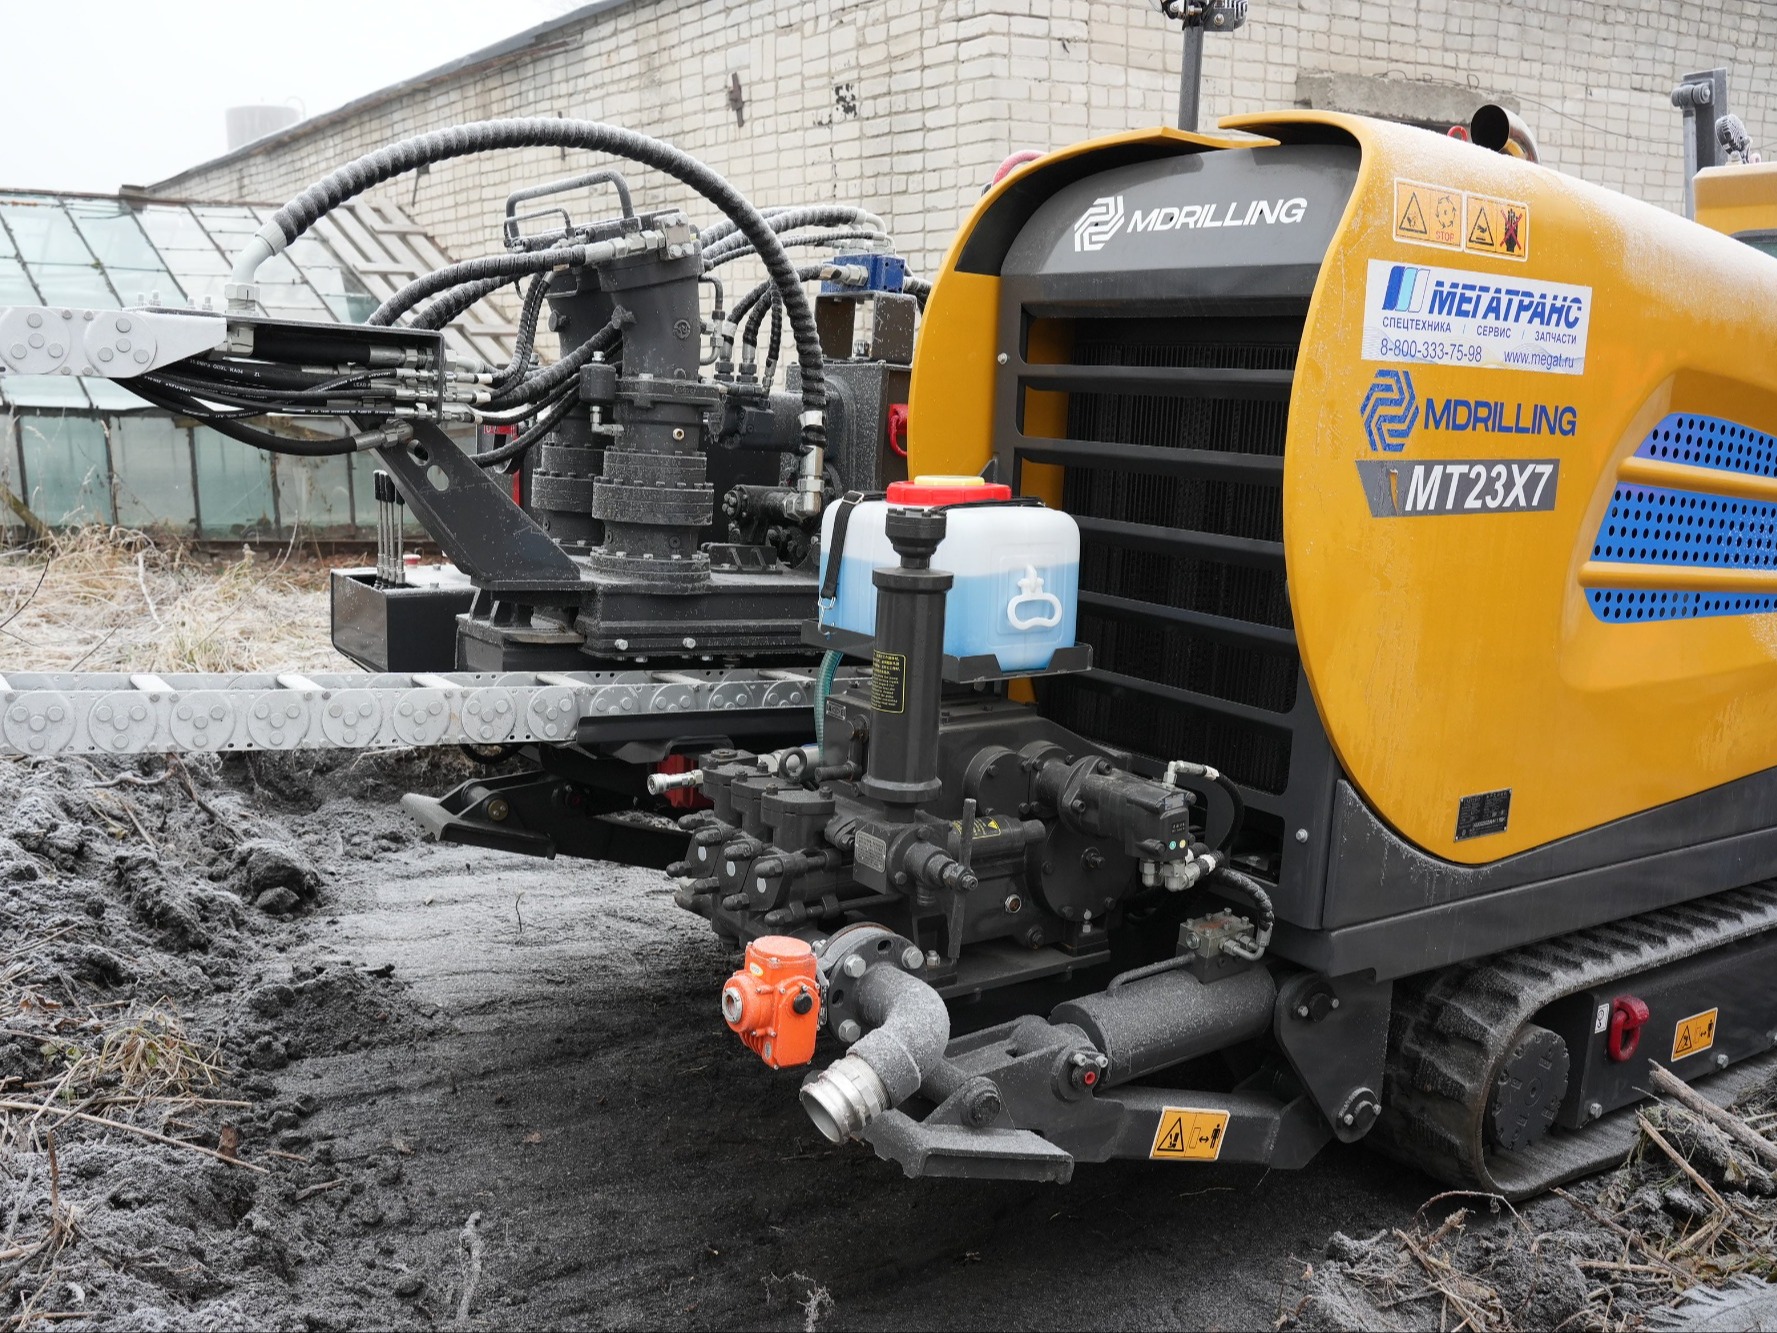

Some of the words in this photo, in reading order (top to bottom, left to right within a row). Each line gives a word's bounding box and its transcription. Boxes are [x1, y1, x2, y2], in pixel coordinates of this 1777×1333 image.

[1127, 197, 1308, 233] MDRILLING
[1435, 230, 1455, 242] STOP
[1428, 280, 1583, 329] МЕГАТРАНС
[1382, 316, 1452, 333] СПЕЦТЕХНИКА
[1476, 324, 1512, 339] СЕРВИС
[1534, 330, 1577, 345] ЗАПЧАСТИ
[1380, 338, 1482, 363] 8-800-333-75-98
[1503, 349, 1575, 370] www.megat.ru
[1423, 397, 1578, 436] MDRILLING
[1404, 463, 1554, 511] MT23X7
